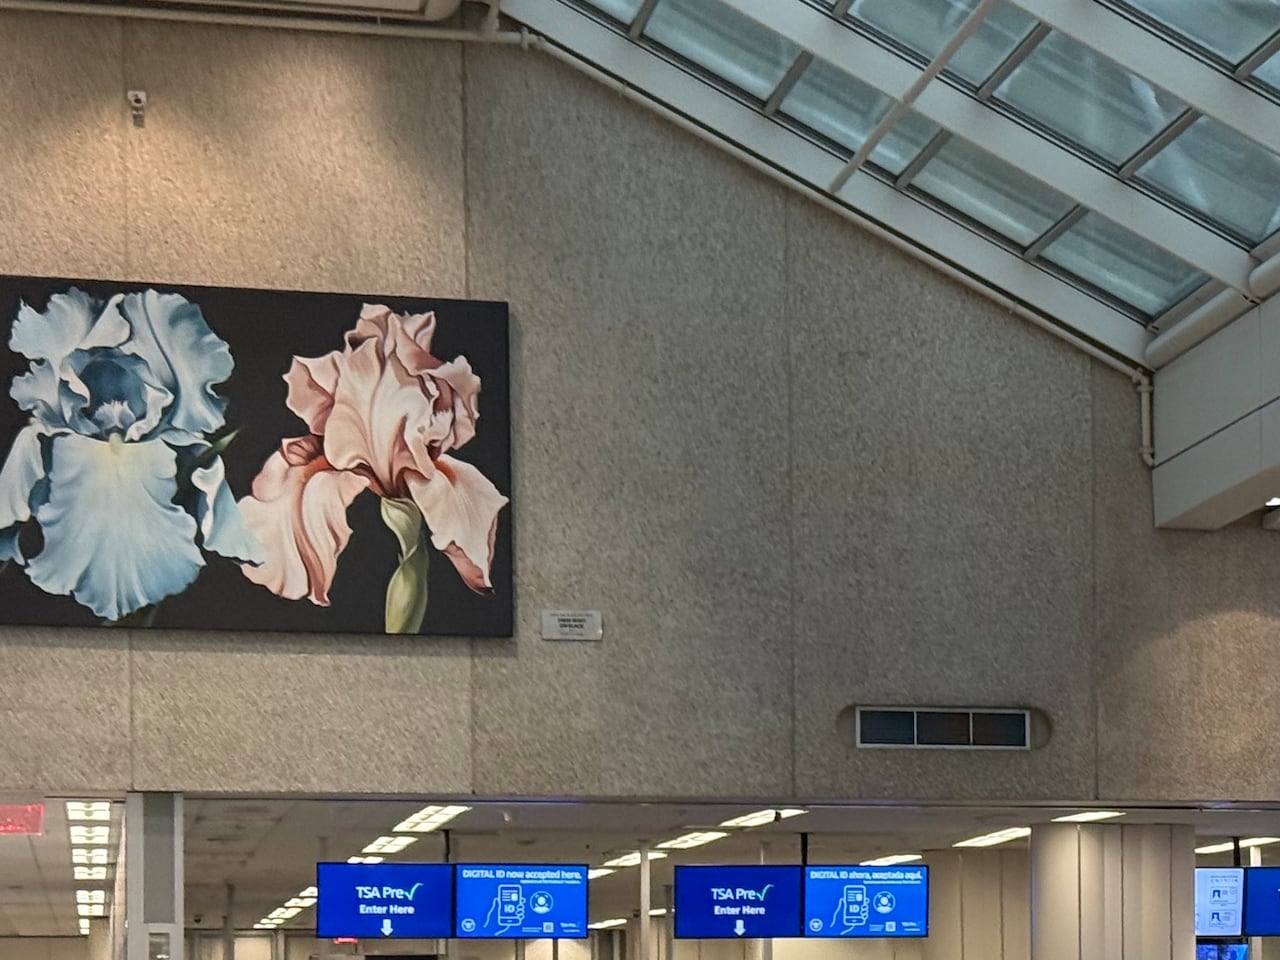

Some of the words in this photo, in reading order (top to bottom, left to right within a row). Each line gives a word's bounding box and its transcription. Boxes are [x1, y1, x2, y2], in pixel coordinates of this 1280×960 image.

[462, 869, 495, 879] DIGITAL
[496, 869, 505, 879] ID
[506, 871, 524, 879] now
[525, 870, 560, 880] accepted
[810, 871, 839, 879] DIGITAL
[839, 871, 848, 879] ID
[355, 886, 380, 899] TSA
[383, 886, 404, 899] Pre
[711, 888, 734, 900] TSA
[735, 888, 757, 900] Pre
[359, 904, 387, 914] Enter
[389, 904, 415, 914] Here
[504, 904, 515, 913] ID
[714, 905, 740, 915] Enter
[742, 906, 766, 915] Here
[849, 904, 860, 913] ID
